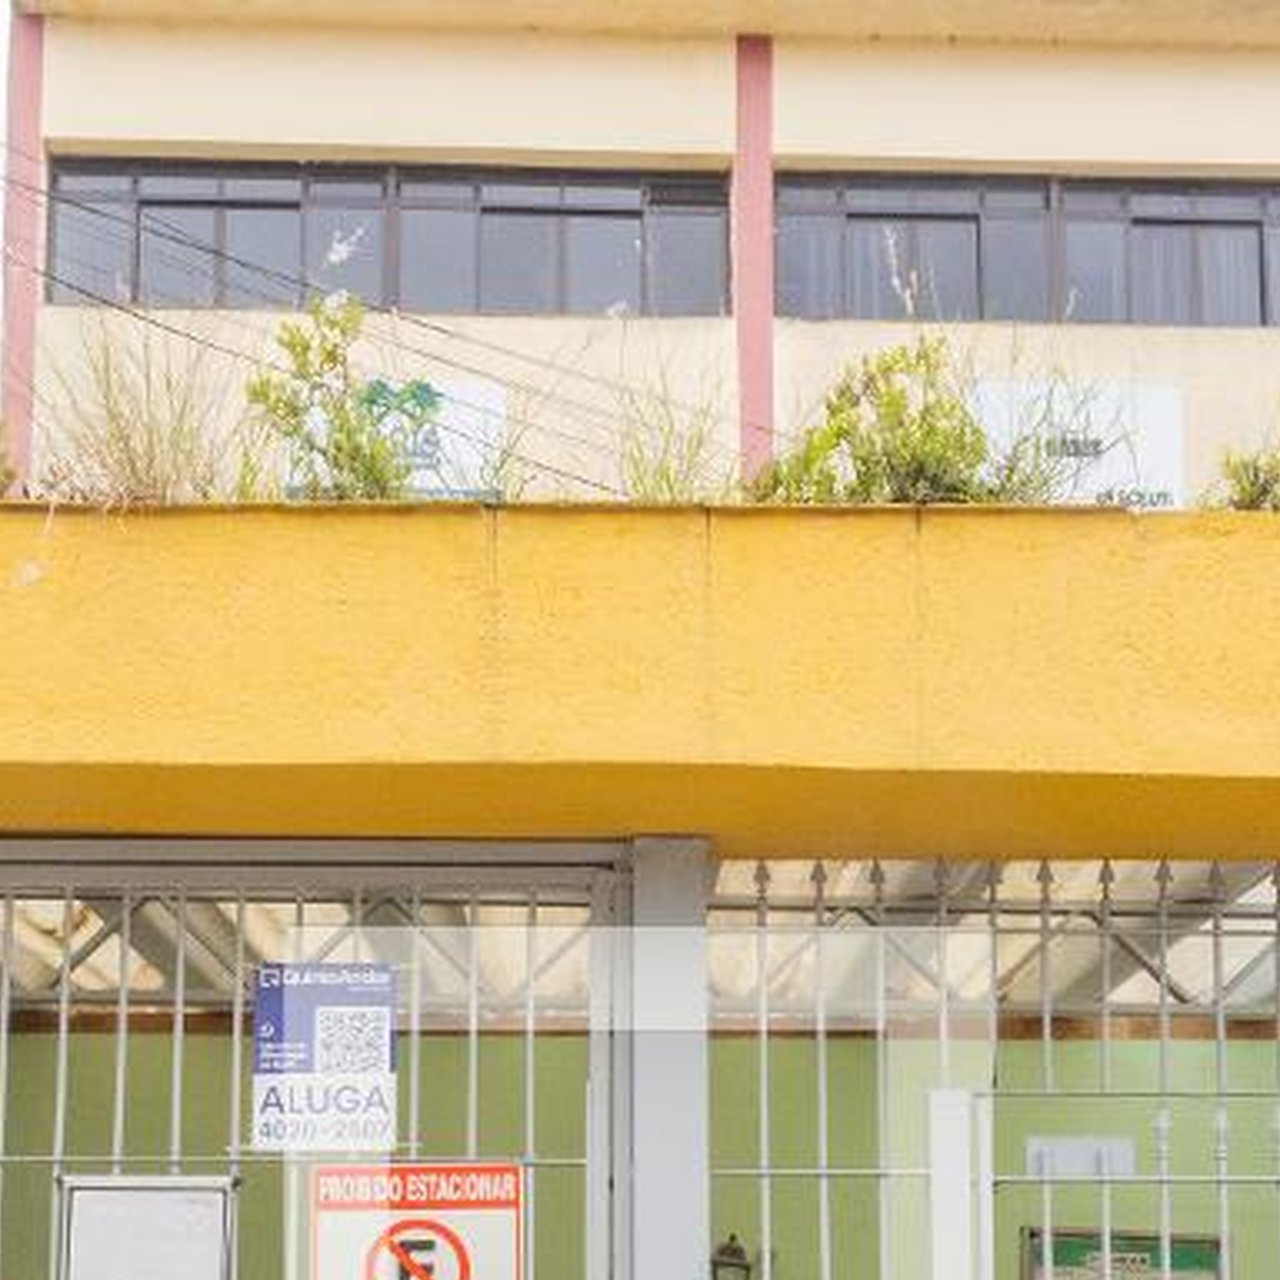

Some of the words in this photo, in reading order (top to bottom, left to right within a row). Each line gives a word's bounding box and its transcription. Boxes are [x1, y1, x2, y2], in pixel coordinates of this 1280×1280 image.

[259, 1085, 389, 1116] ALUGA
[320, 1173, 402, 1202] PROIBIDO
[406, 1172, 517, 1202] ESTACIONAR
